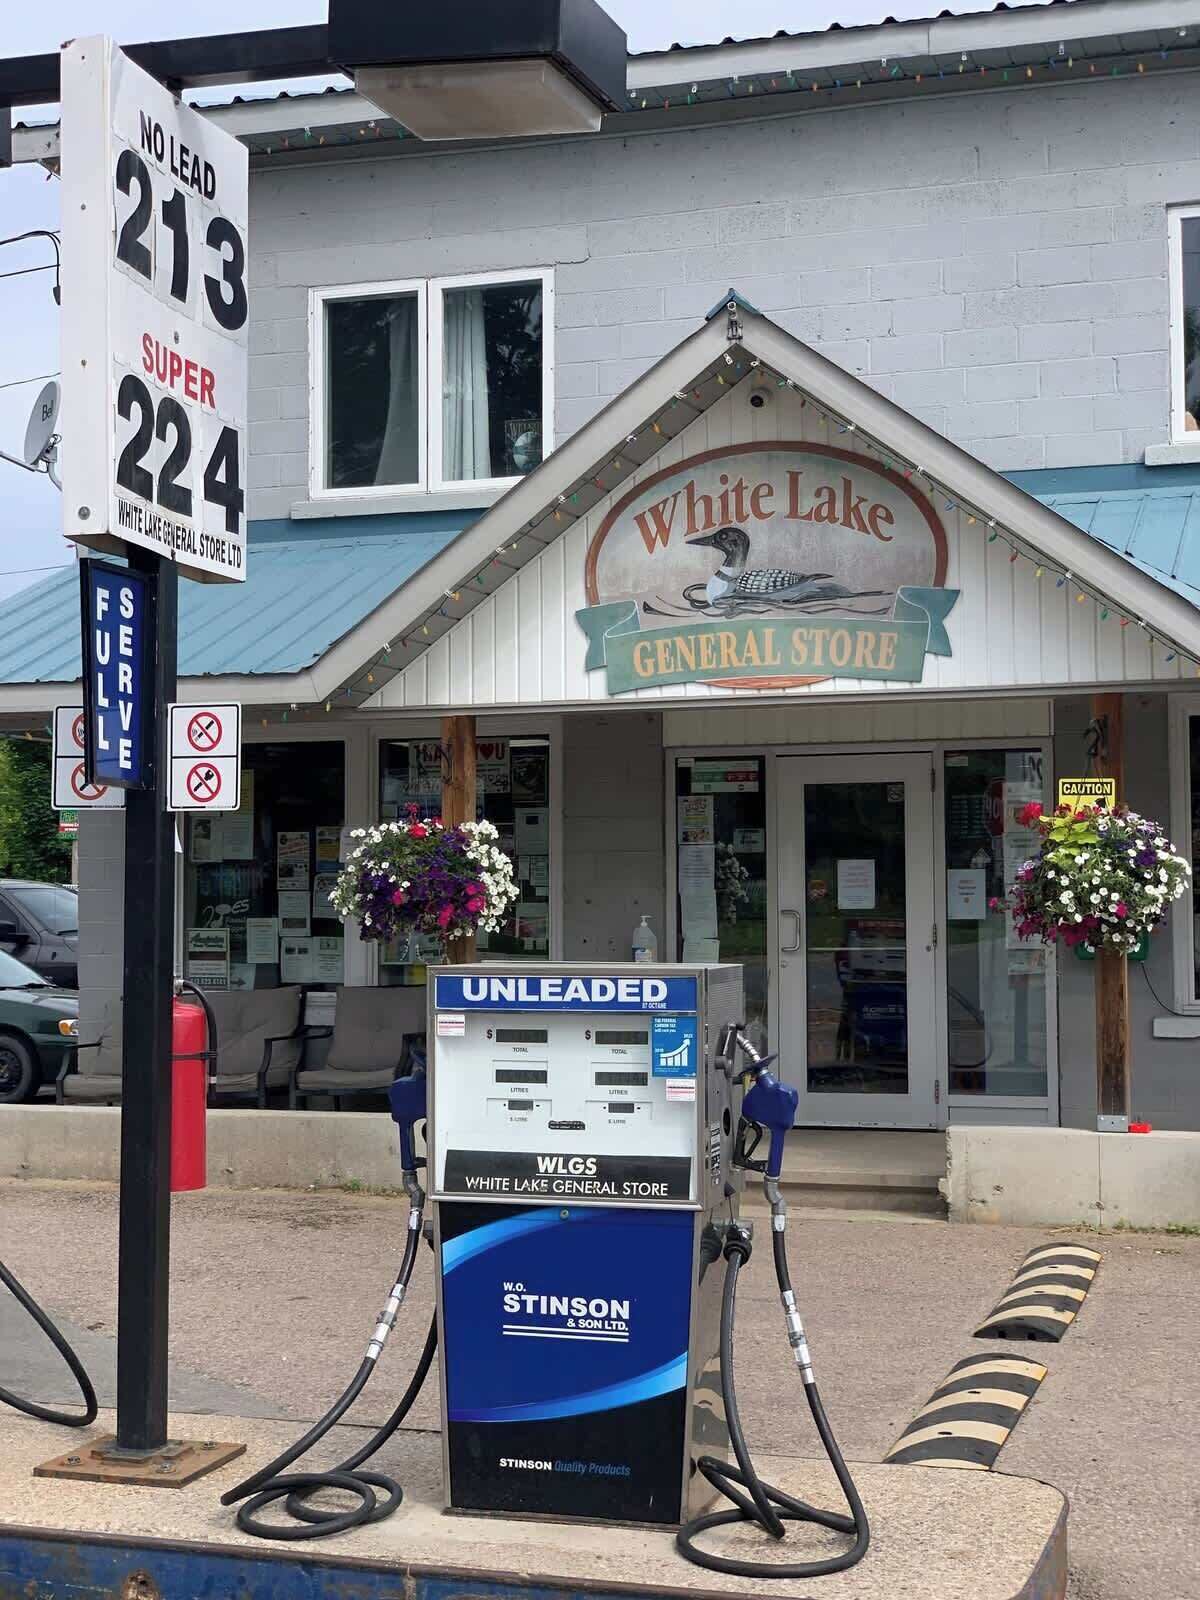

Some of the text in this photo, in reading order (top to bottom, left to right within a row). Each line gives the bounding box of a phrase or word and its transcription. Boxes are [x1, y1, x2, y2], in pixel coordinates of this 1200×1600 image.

[140, 110, 216, 200] NO LEAD
[116, 149, 248, 331] 213
[142, 332, 216, 409] SUPER
[116, 374, 244, 535] 224
[633, 470, 895, 555] White Lake
[118, 499, 242, 568] WHITE LAKE GENERAL STORE LTD
[633, 628, 898, 678] GENERAL STORE
[96, 587, 110, 750] FULL
[118, 587, 135, 770] SERVE
[1062, 783, 1112, 796] CAUTION
[462, 978, 668, 1003] UNLEADED
[486, 1028, 493, 1040] $
[585, 1029, 591, 1041] $
[537, 1156, 597, 1174] WLGS
[465, 1176, 668, 1196] WHITE LAKE GENERAL STORE
[503, 1282, 526, 1292] W.O.
[503, 1293, 630, 1320] STINSON
[567, 1318, 629, 1331] & SON LTD.
[499, 1457, 631, 1476] STINSON Quality Products
